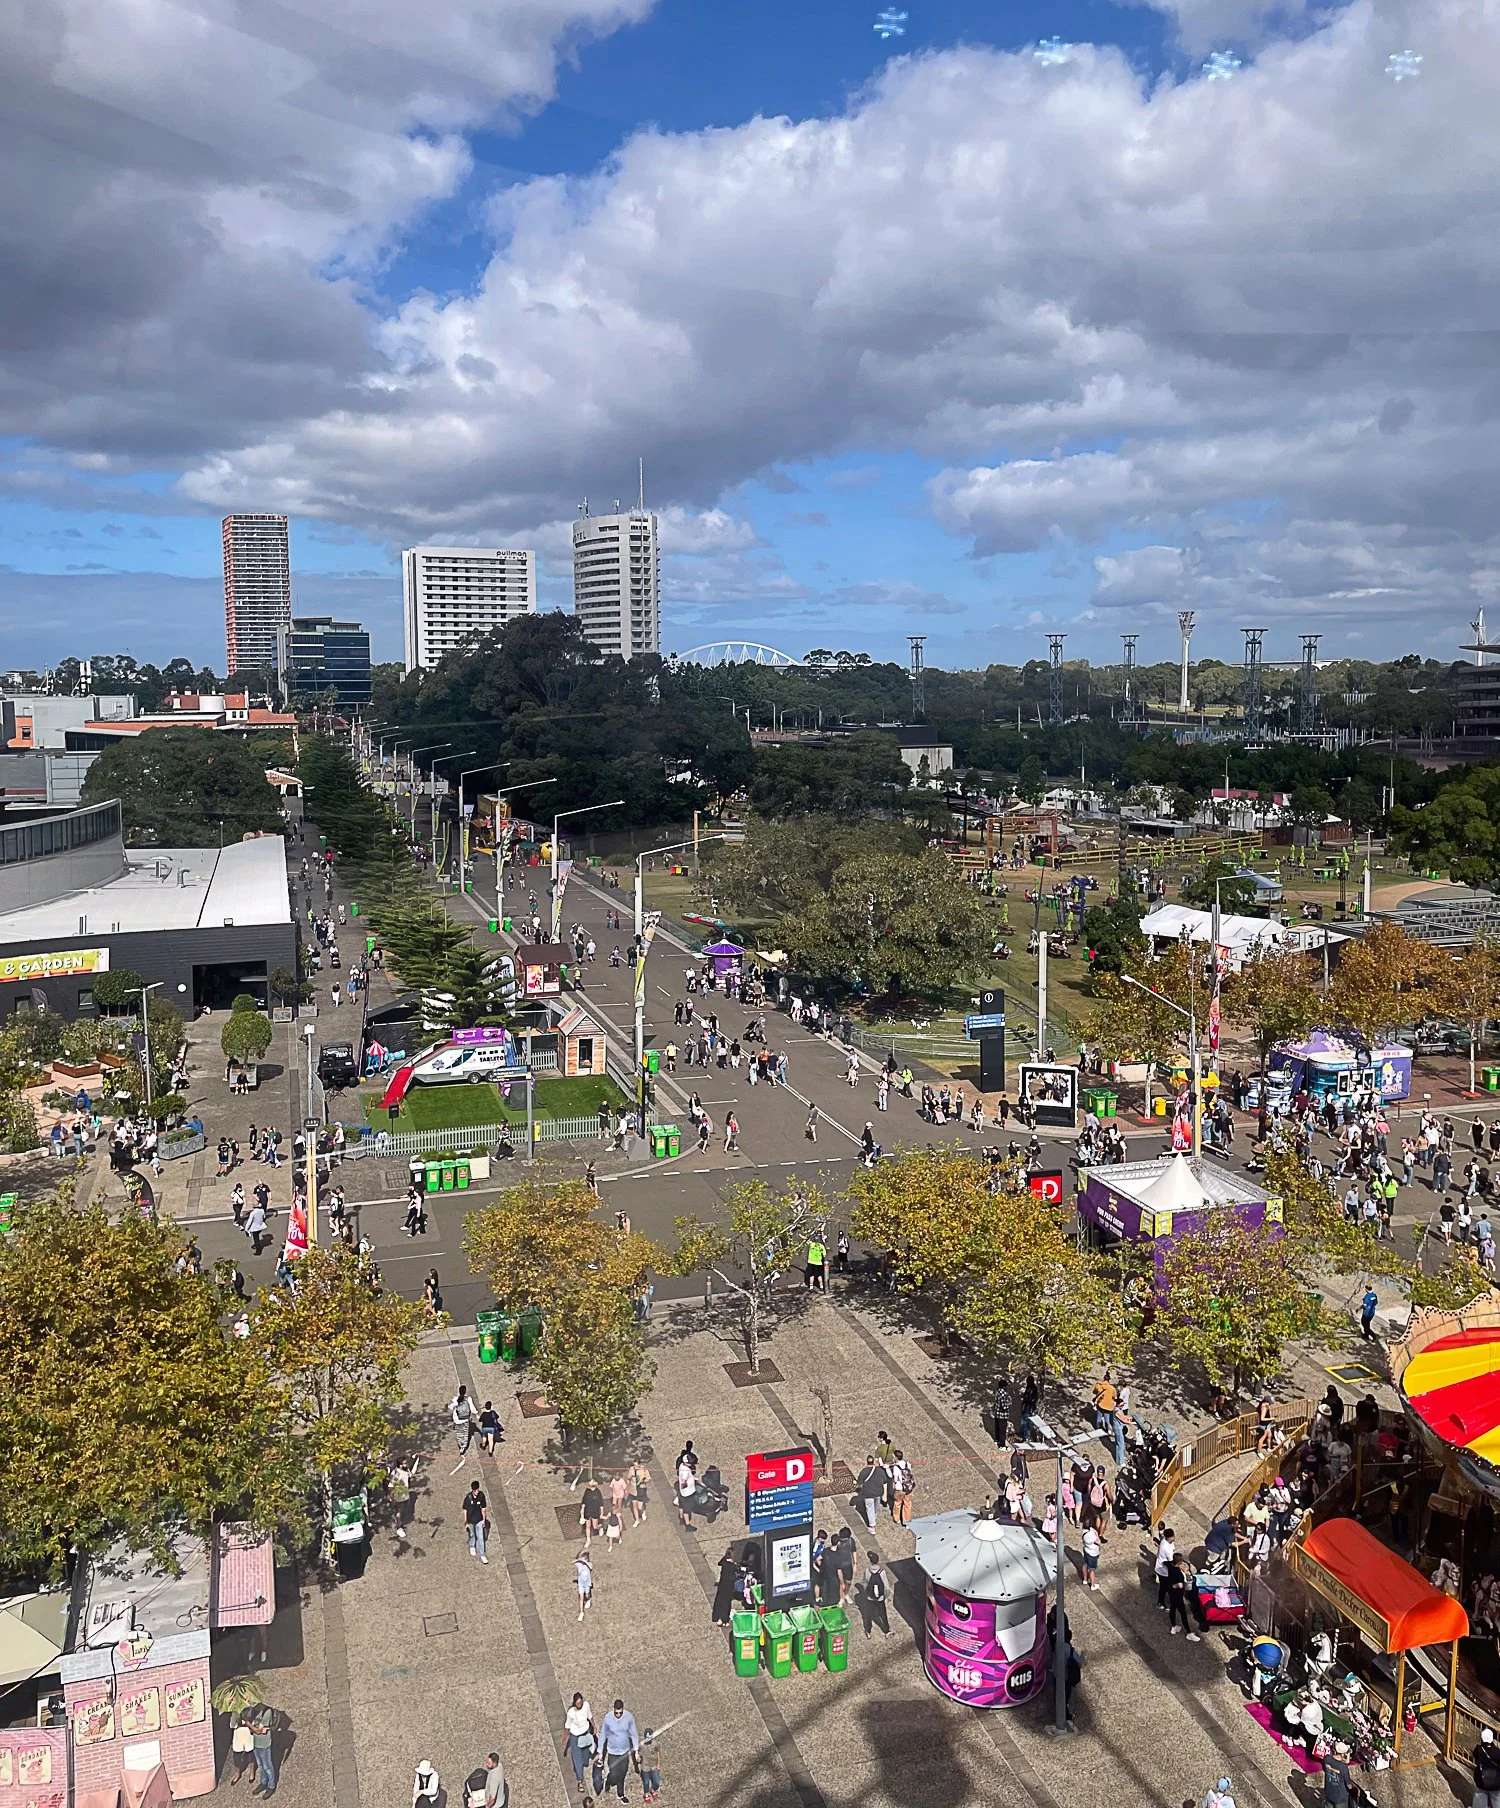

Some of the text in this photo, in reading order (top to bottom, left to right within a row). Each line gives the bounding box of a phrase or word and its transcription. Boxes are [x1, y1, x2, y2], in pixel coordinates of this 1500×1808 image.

[496, 550, 527, 558] pullman
[4, 956, 84, 975] & GARDEN
[1041, 1179, 1059, 1200] D
[757, 1459, 806, 1482] Gate D
[1317, 1570, 1338, 1597] Double
[1339, 1588, 1360, 1616] Decker
[953, 1603, 969, 1615] KIIS
[948, 1664, 983, 1688] KIIS
[1010, 1670, 1032, 1687] KIIS
[168, 1682, 199, 1702] SUNDAES
[125, 1693, 153, 1711] SHAKES
